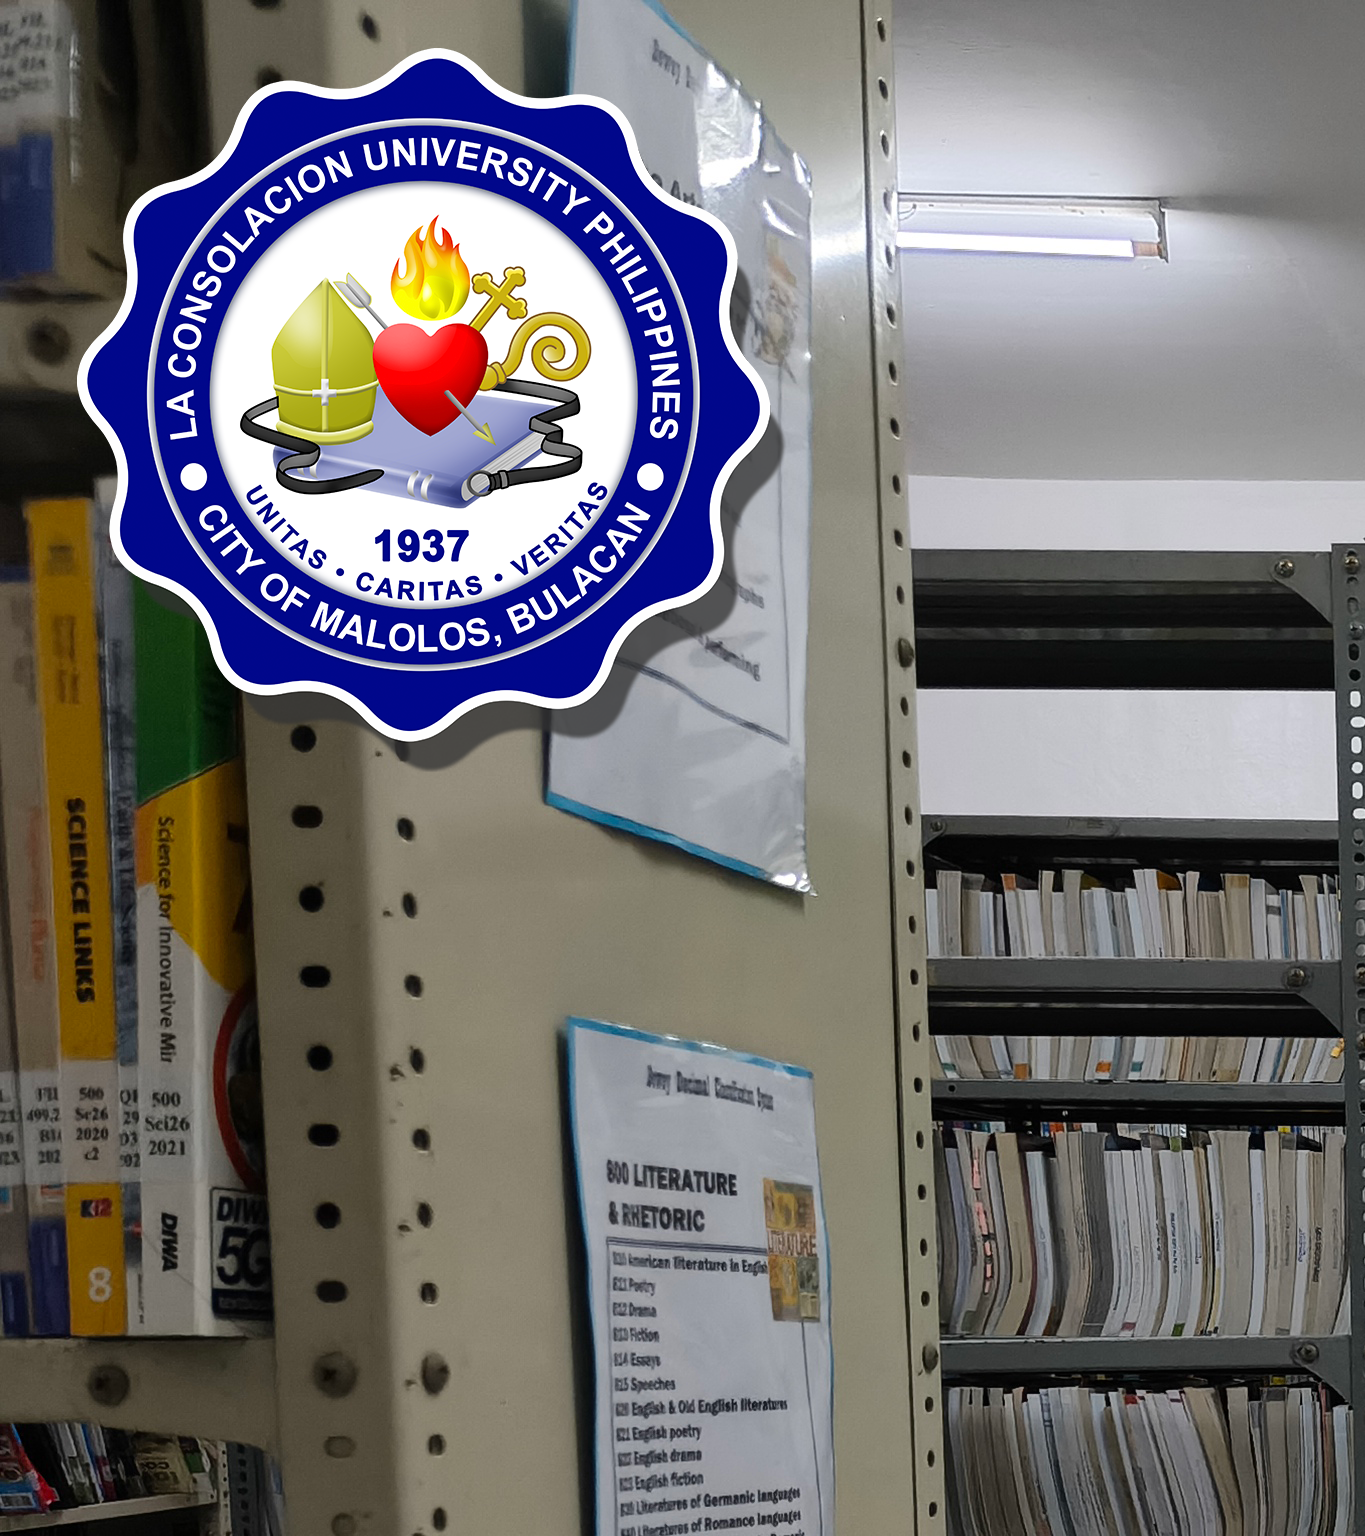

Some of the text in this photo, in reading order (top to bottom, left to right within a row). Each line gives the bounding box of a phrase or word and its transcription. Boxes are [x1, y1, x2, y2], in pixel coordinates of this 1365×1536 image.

[66, 797, 95, 1004] SCIENCE LINKS
[157, 816, 176, 1028] Science for Innovative
[79, 1086, 104, 1100] 500
[152, 1091, 181, 1107] 500
[145, 1115, 190, 1132] Sci26
[75, 1127, 109, 1141] 2020
[149, 1140, 186, 1156] 2021
[634, 1163, 738, 1196] LITERATURE
[608, 1201, 705, 1233] & RHETORIC
[161, 1212, 179, 1273] DIWA
[88, 1266, 112, 1303] 8
[629, 1302, 657, 1318] Drama
[630, 1327, 660, 1343] Fiction
[630, 1377, 676, 1394] Speeches
[678, 1399, 696, 1414] Old
[698, 1398, 738, 1416] English
[633, 1424, 702, 1443] English poetry
[635, 1472, 704, 1492] English fiction
[690, 1494, 703, 1509] of
[704, 1490, 755, 1508] Germanic
[757, 1487, 801, 1504] languages
[691, 1517, 703, 1532] of
[704, 1514, 755, 1531] Romance
